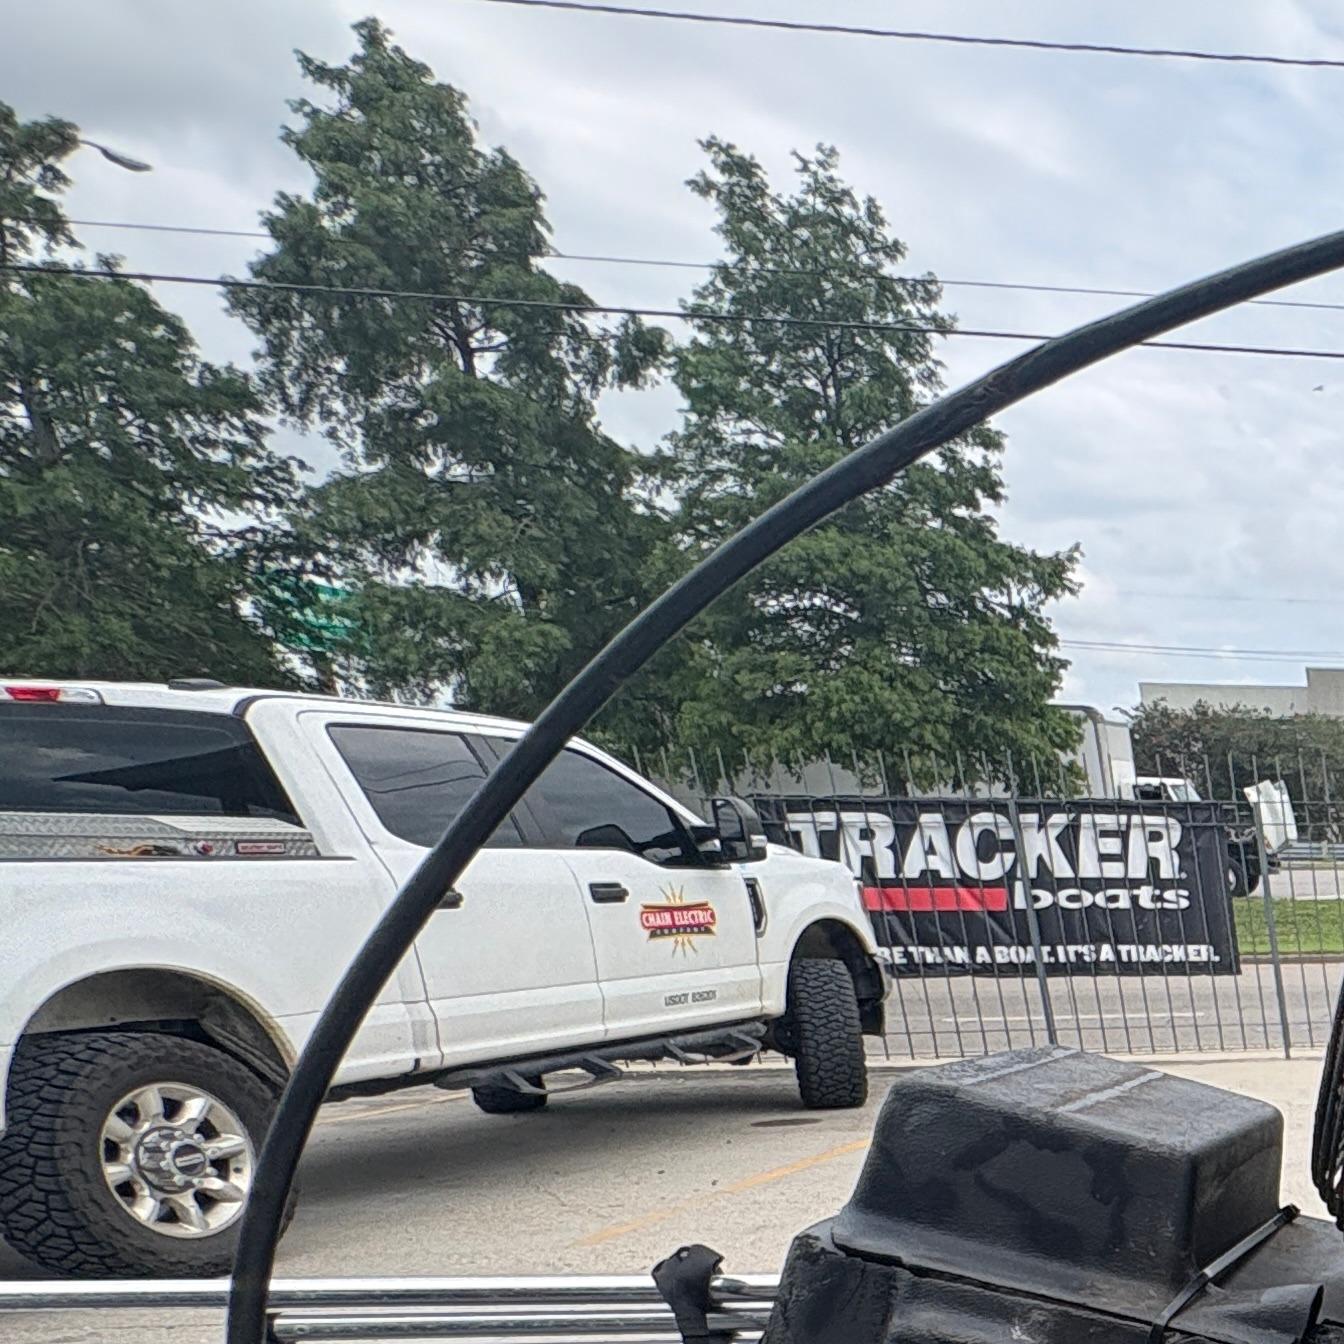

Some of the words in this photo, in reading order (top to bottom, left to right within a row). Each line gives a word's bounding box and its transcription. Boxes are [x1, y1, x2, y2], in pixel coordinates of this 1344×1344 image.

[786, 811, 1186, 880] TRACKER
[1013, 880, 1190, 911] boats
[642, 911, 672, 927] CHAIN
[674, 908, 714, 926] ELECTRIC
[907, 946, 970, 964] THAN
[976, 945, 992, 964] A
[1100, 943, 1116, 963] A
